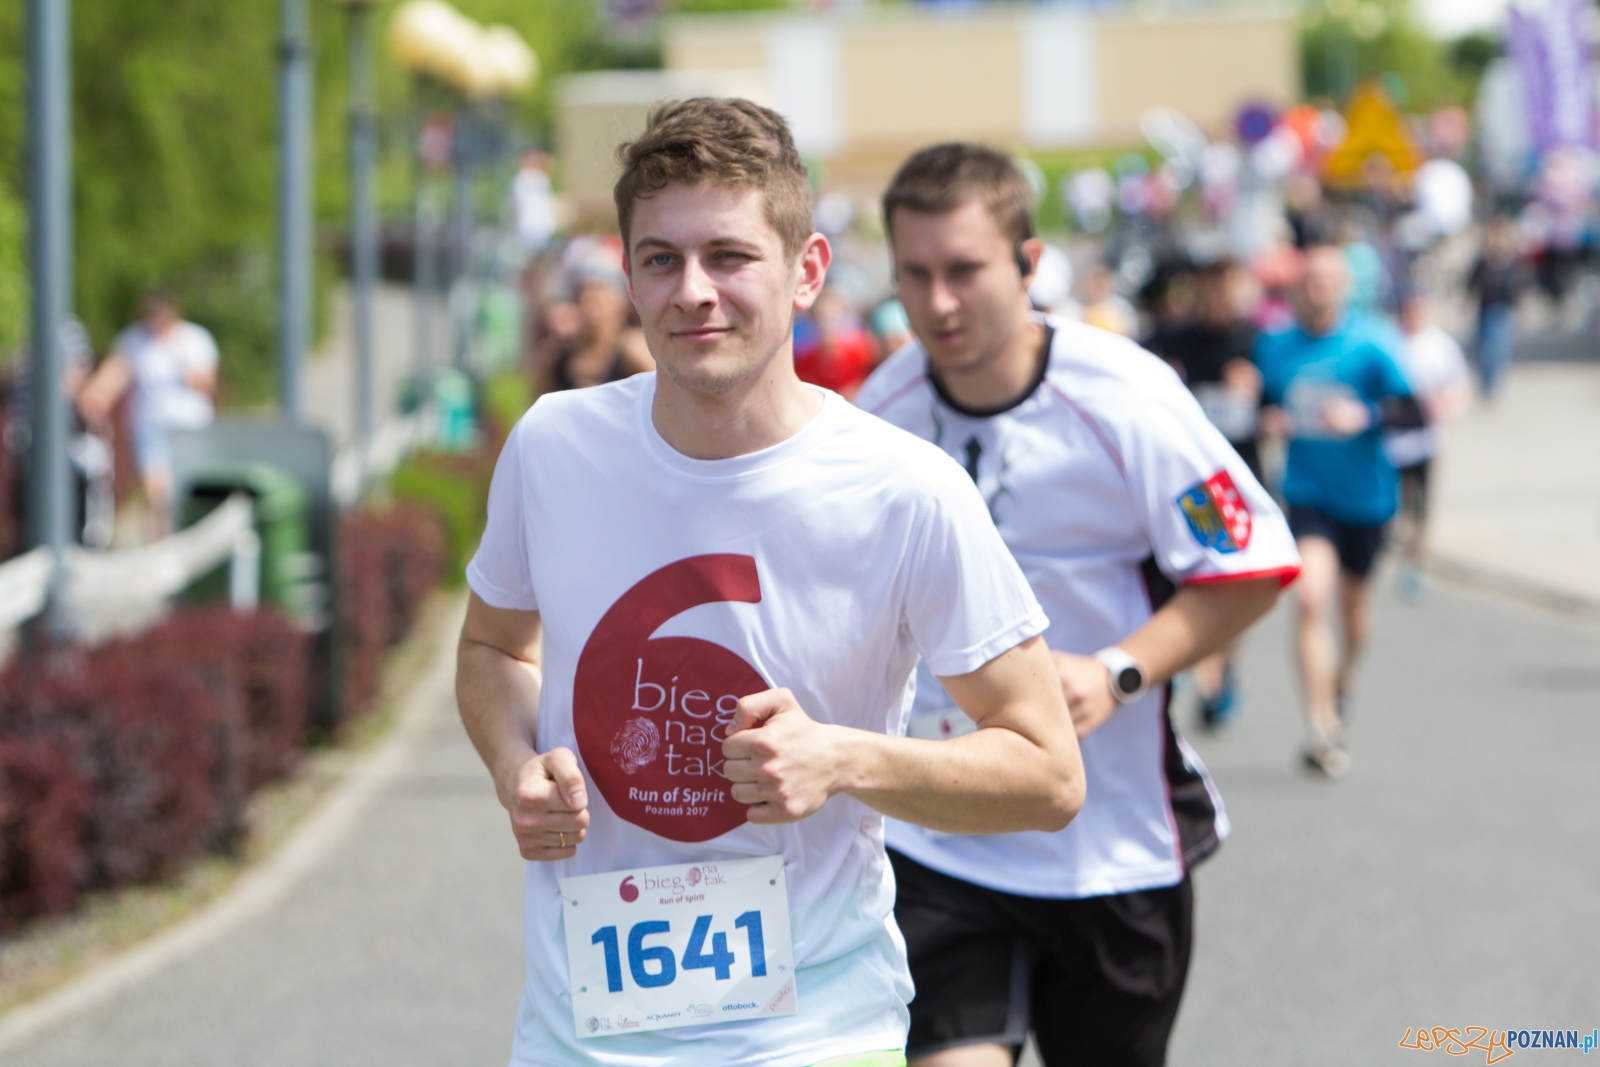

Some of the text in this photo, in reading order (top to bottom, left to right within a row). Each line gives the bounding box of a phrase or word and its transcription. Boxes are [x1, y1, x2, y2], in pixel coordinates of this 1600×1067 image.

[631, 658, 740, 743] bieg
[665, 719, 707, 746] na
[664, 743, 728, 780] tak
[629, 787, 725, 806] Run of Spirit
[645, 804, 709, 817] Poznań 2017
[702, 864, 718, 875] na
[704, 873, 727, 886] tak
[643, 871, 685, 896] bieg
[659, 893, 705, 905] Run of Spirit
[591, 910, 768, 993] 1641
